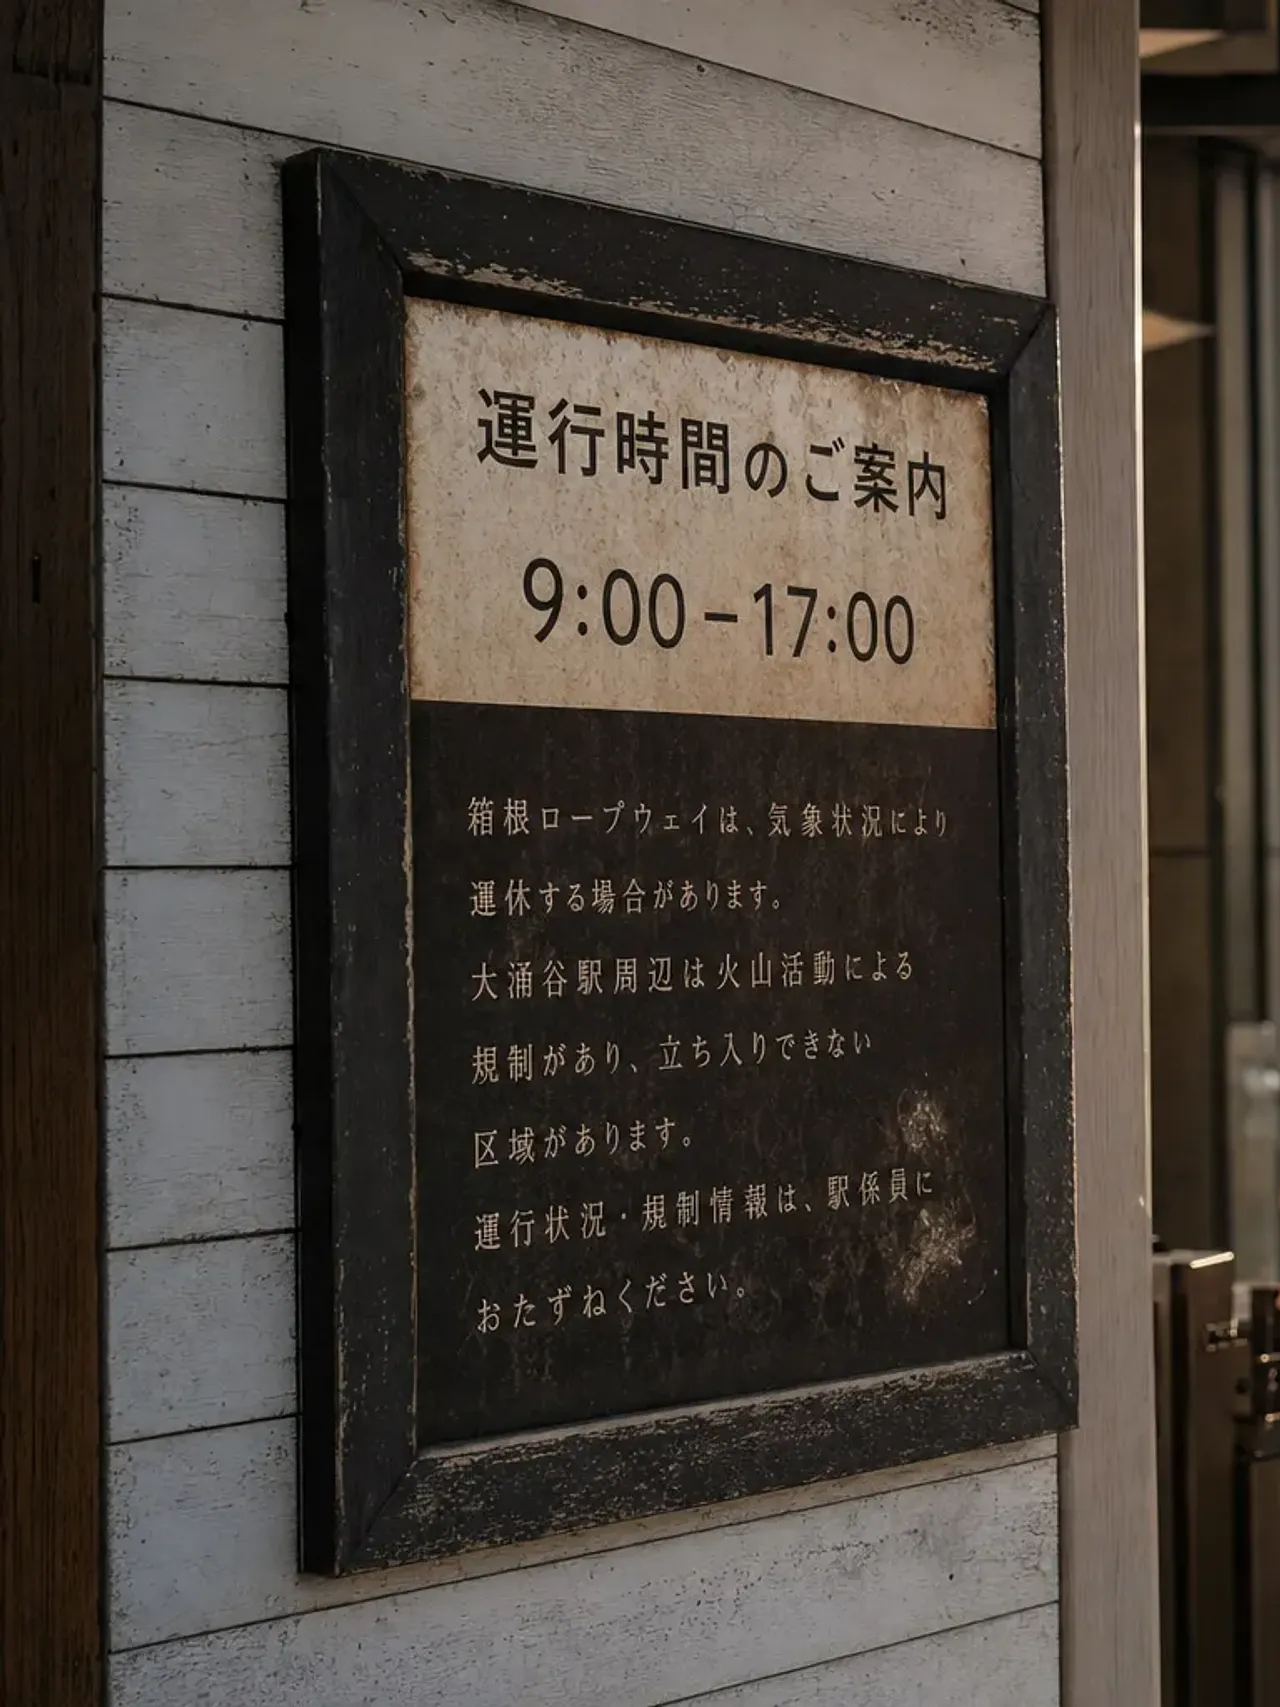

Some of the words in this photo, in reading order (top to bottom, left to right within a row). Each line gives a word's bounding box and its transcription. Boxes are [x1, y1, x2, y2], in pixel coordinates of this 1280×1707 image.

[477, 388, 947, 520] 運行時間のご案内
[467, 796, 948, 838] 箱根ロープウェイは、気象状況により
[469, 878, 783, 917] 運休する場合があります。
[471, 951, 914, 1001] 大涌谷駅周辺は火山活動による
[471, 1028, 872, 1085] 規制があり、立ち入りできない
[474, 1117, 693, 1168] 区域があります。
[474, 1168, 934, 1251] 運行状況・規制情報は、駅係員に
[477, 1272, 746, 1333] おたずねください。
